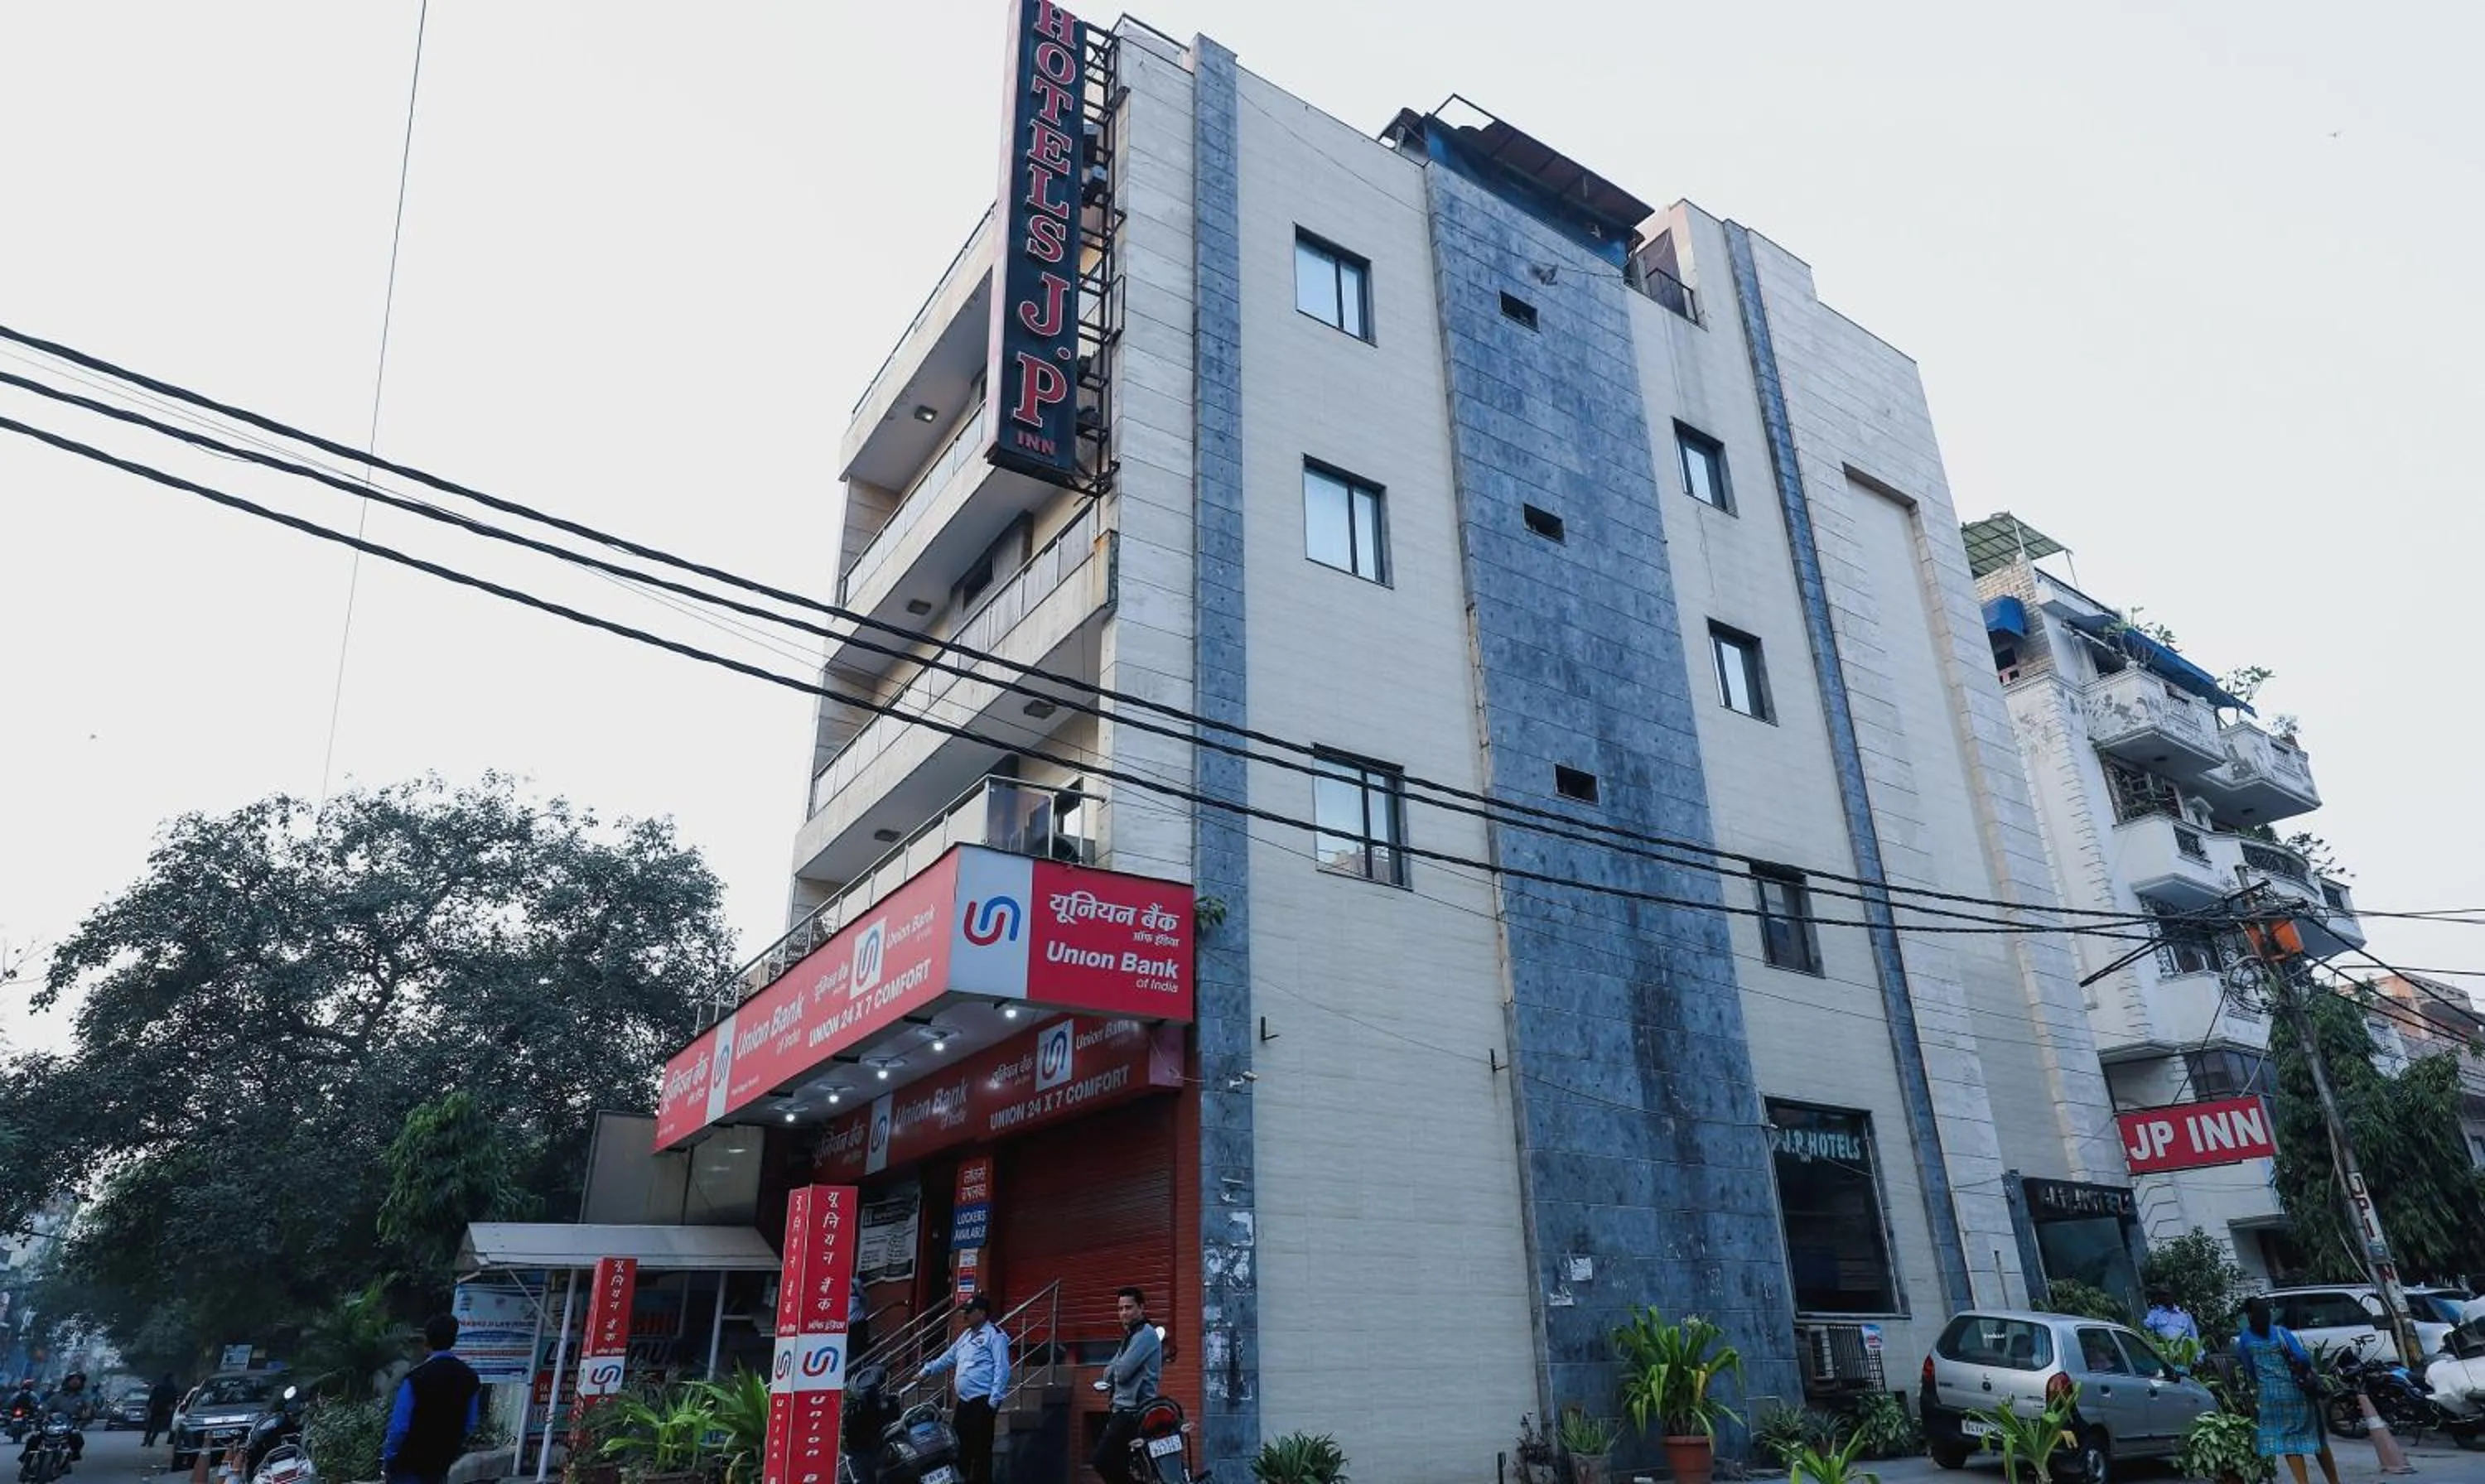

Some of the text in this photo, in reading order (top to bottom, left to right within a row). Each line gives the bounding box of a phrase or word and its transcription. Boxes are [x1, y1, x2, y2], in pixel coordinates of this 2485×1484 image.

[1026, 0, 1078, 263] HOTELS
[1017, 431, 1056, 455] INN
[1049, 890, 1180, 931] यूनियन बैंक
[1046, 940, 1180, 980] Union Bank
[875, 958, 932, 1009] COMFORT
[1136, 977, 1179, 993] of India
[770, 990, 805, 1037] Bank
[895, 1079, 968, 1130] Union Bank
[990, 1065, 1131, 1130] UNION 24 X 7 COMFORT
[1807, 1130, 1860, 1160] HOTELS
[2130, 1107, 2267, 1160] JP INN
[957, 1210, 987, 1226] LOCKERS
